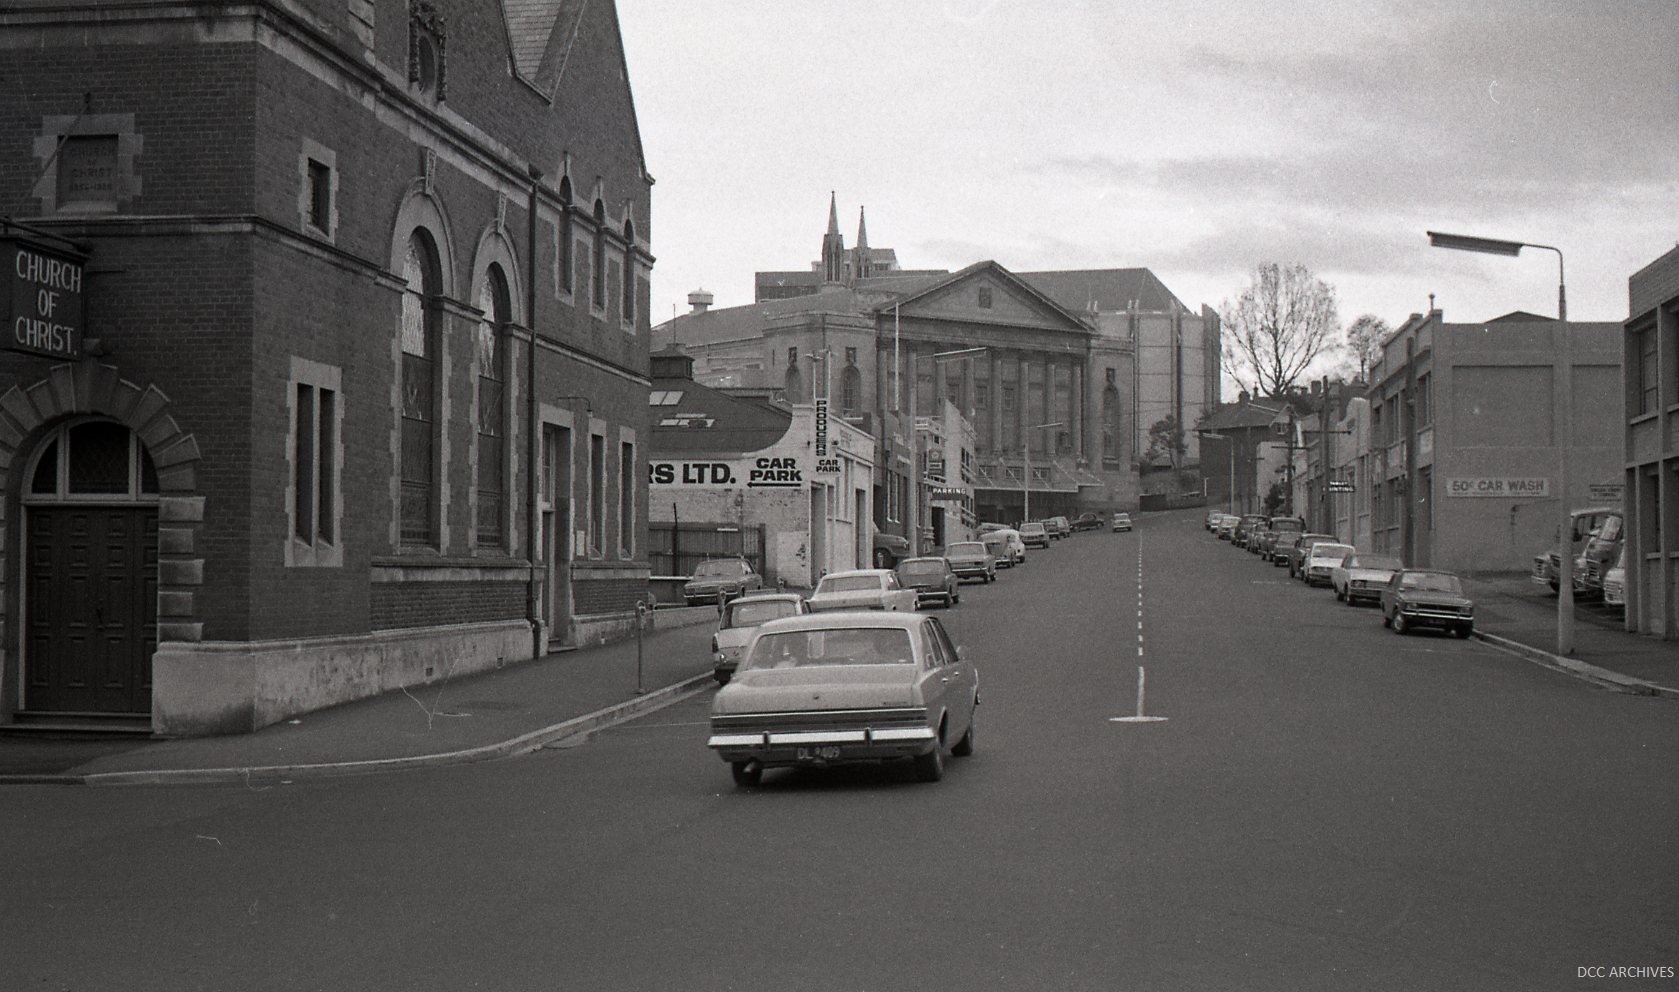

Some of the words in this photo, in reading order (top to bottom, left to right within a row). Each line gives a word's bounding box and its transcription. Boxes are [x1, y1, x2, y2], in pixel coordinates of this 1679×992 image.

[16, 250, 82, 294] CHURCH
[37, 288, 60, 319] OF
[15, 315, 78, 356] CHRIST.
[816, 400, 827, 456] PRODUCERS
[683, 463, 736, 484] LTD.
[756, 457, 796, 469] CAR
[816, 465, 841, 473] PARK
[750, 469, 802, 482] PARK
[1478, 480, 1503, 491] CAR
[1507, 480, 1544, 491] WASH
